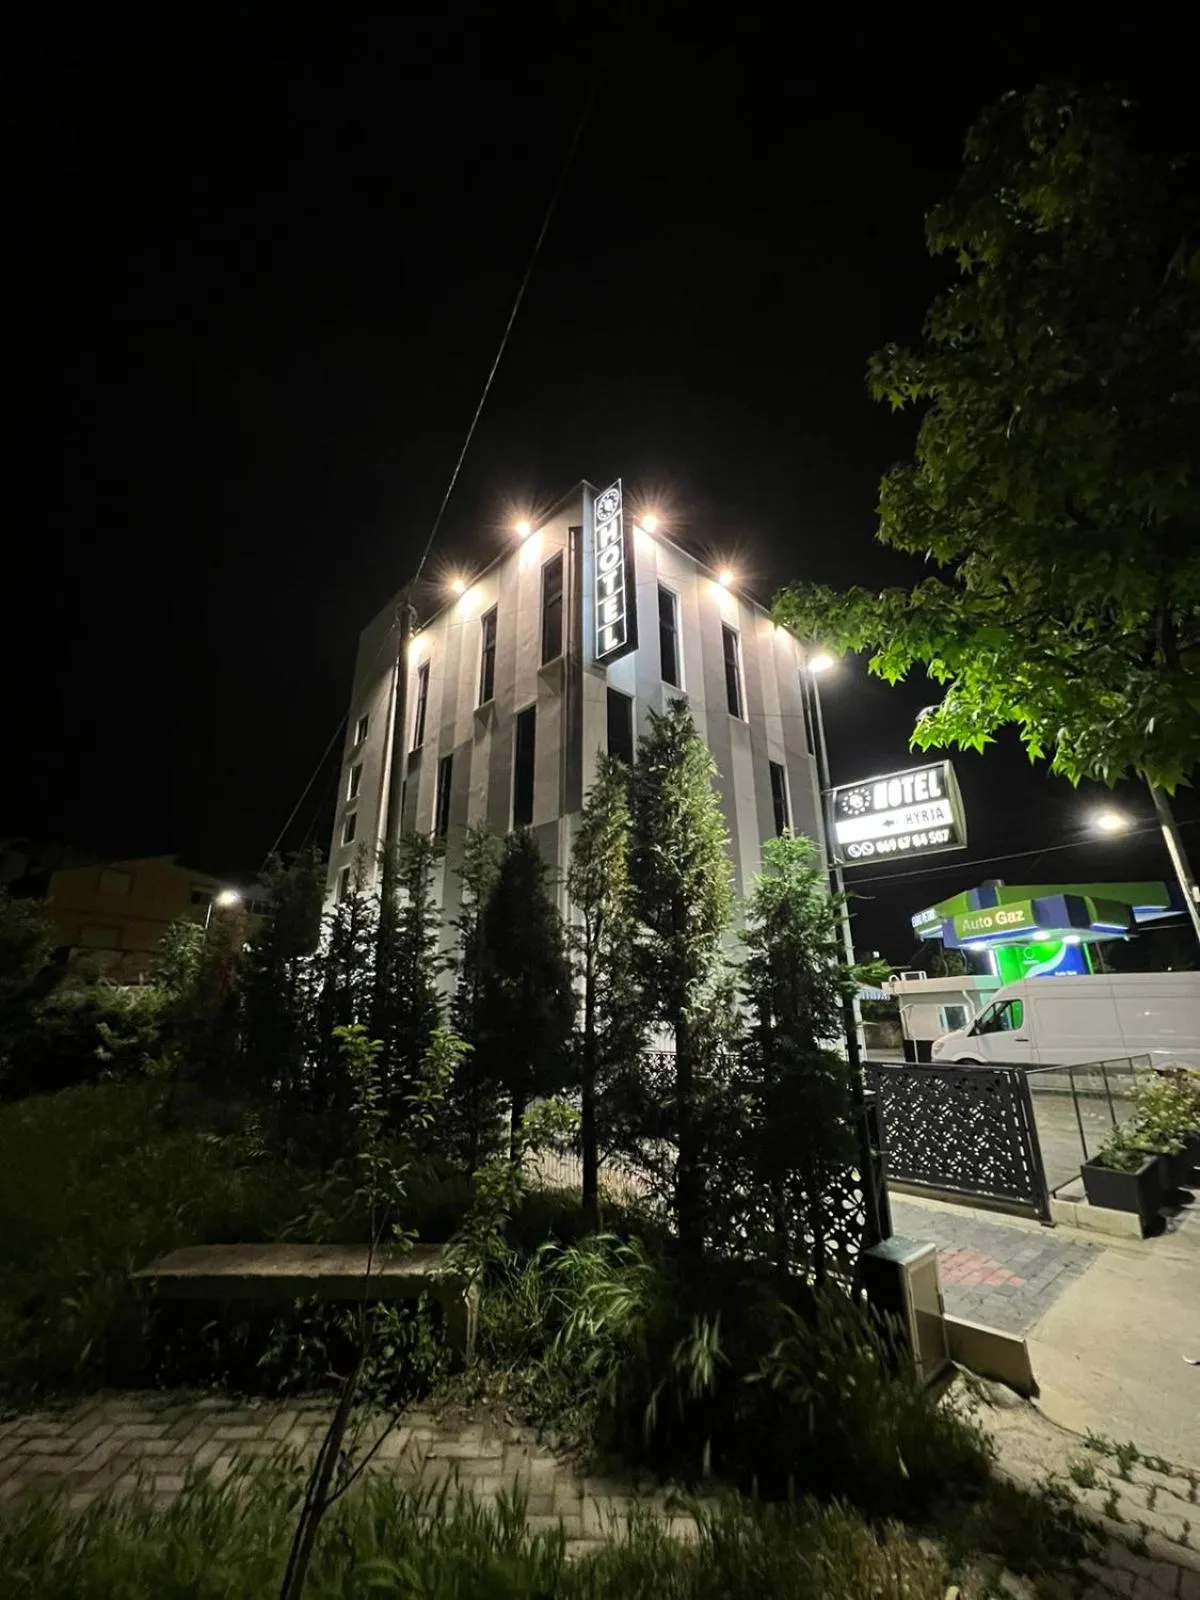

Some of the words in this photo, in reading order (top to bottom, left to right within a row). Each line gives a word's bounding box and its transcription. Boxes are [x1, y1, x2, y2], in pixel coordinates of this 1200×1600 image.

[599, 522, 620, 651] HOTEL
[962, 916, 993, 932] Auto
[995, 910, 1025, 925] Gaz
